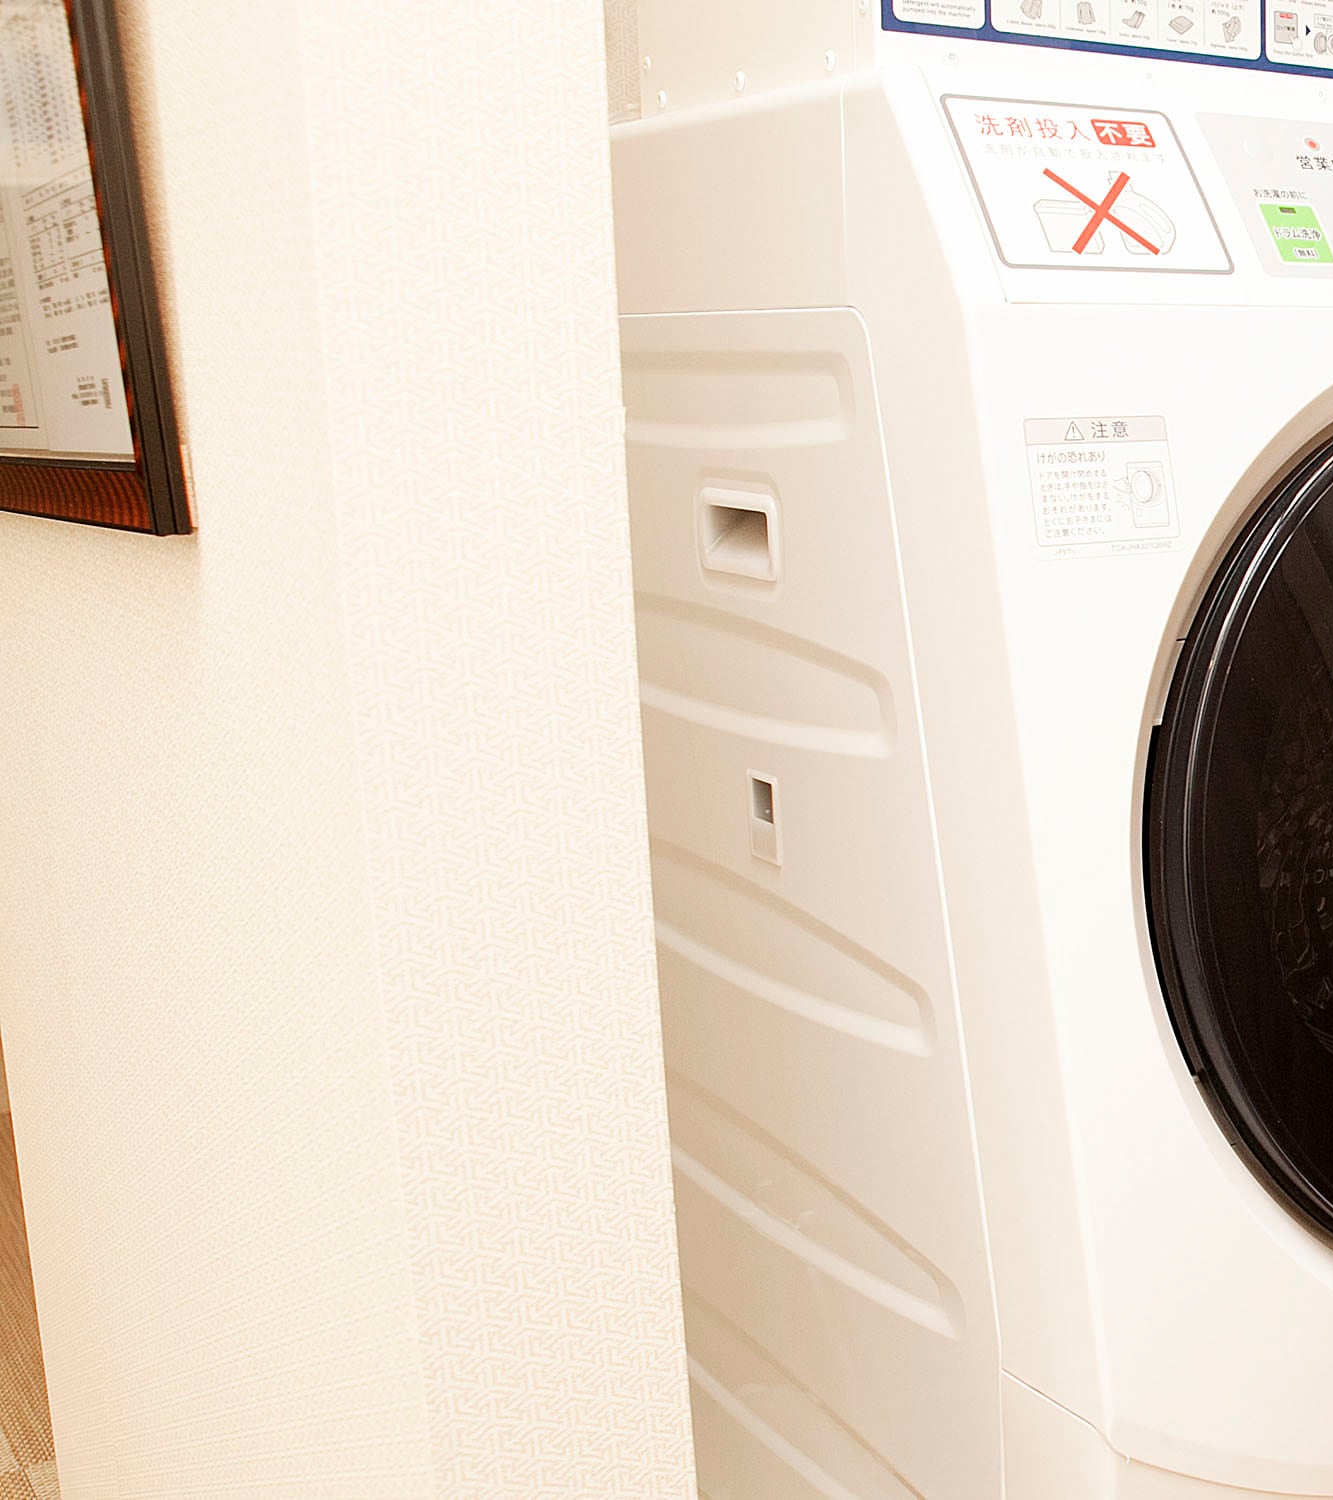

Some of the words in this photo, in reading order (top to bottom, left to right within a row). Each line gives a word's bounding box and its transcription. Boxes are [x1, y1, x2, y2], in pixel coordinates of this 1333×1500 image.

[974, 114, 1091, 141] 洗剤投入
[1093, 121, 1153, 147] 不要
[1274, 227, 1322, 241] ドラム洗浄
[1090, 420, 1130, 439] 注意
[1036, 450, 1106, 465] けがの恐れあり
[1039, 468, 1108, 480] ドアを開け閉めする
[1040, 480, 1109, 493] ときは手や指をはさ
[1042, 503, 1112, 516] おそれがあります。
[1043, 514, 1113, 527] とくにお子さまには
